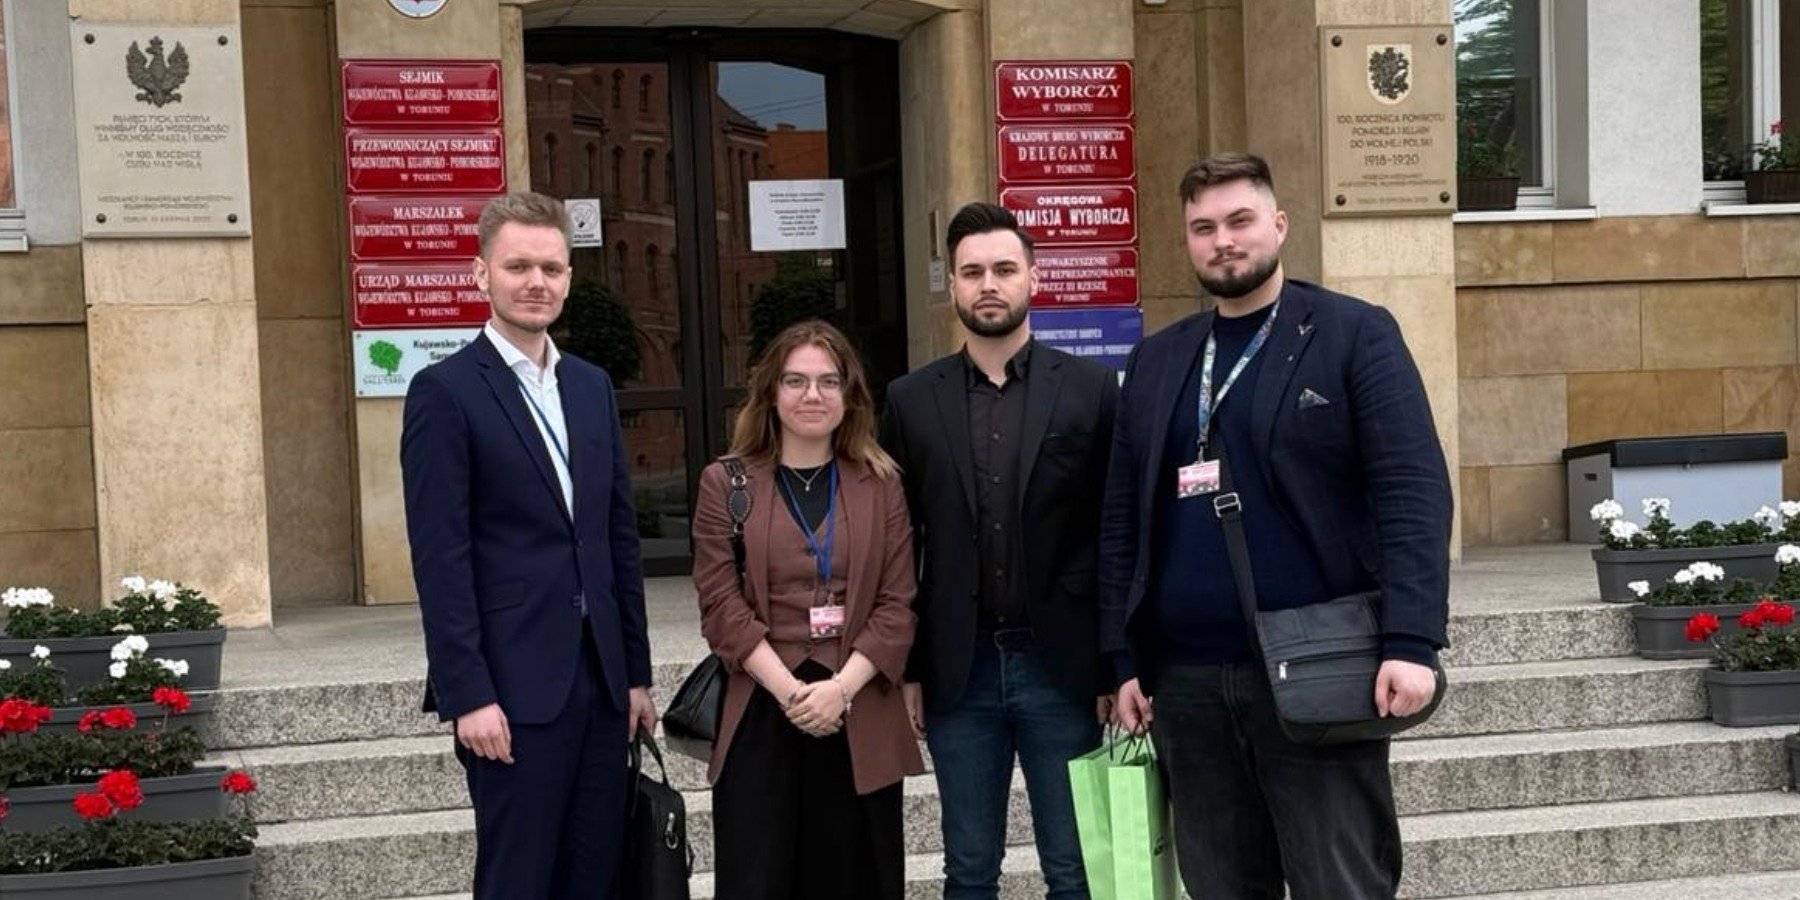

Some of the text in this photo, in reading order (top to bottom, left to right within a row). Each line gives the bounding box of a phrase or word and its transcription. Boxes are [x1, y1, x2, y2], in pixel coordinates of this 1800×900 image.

[399, 71, 444, 83] SEJMIK
[1016, 67, 1117, 80] KOMISARZ
[1012, 85, 1121, 99] WYBORCZY
[410, 106, 450, 114] TORUNIU
[1054, 103, 1094, 112] TORUNIU
[1355, 114, 1399, 123] ROCZNICA
[353, 139, 496, 154] PRZEWODNICZĄCY SEJMIKU
[1349, 139, 1364, 149] DO
[1018, 146, 1118, 161] DELEGATURA
[1364, 154, 1419, 166] 1918-1920
[1056, 165, 1095, 174] TORUNIU
[413, 173, 453, 182] TORUNIU
[1037, 195, 1103, 207] OKRĘGOWA
[393, 207, 464, 219] MARSZAŁEK
[1069, 207, 1130, 225] WYBORCZA
[404, 241, 457, 249] W TORUNIU
[359, 275, 399, 290] URZĄD
[407, 308, 460, 317] W TORUNIU
